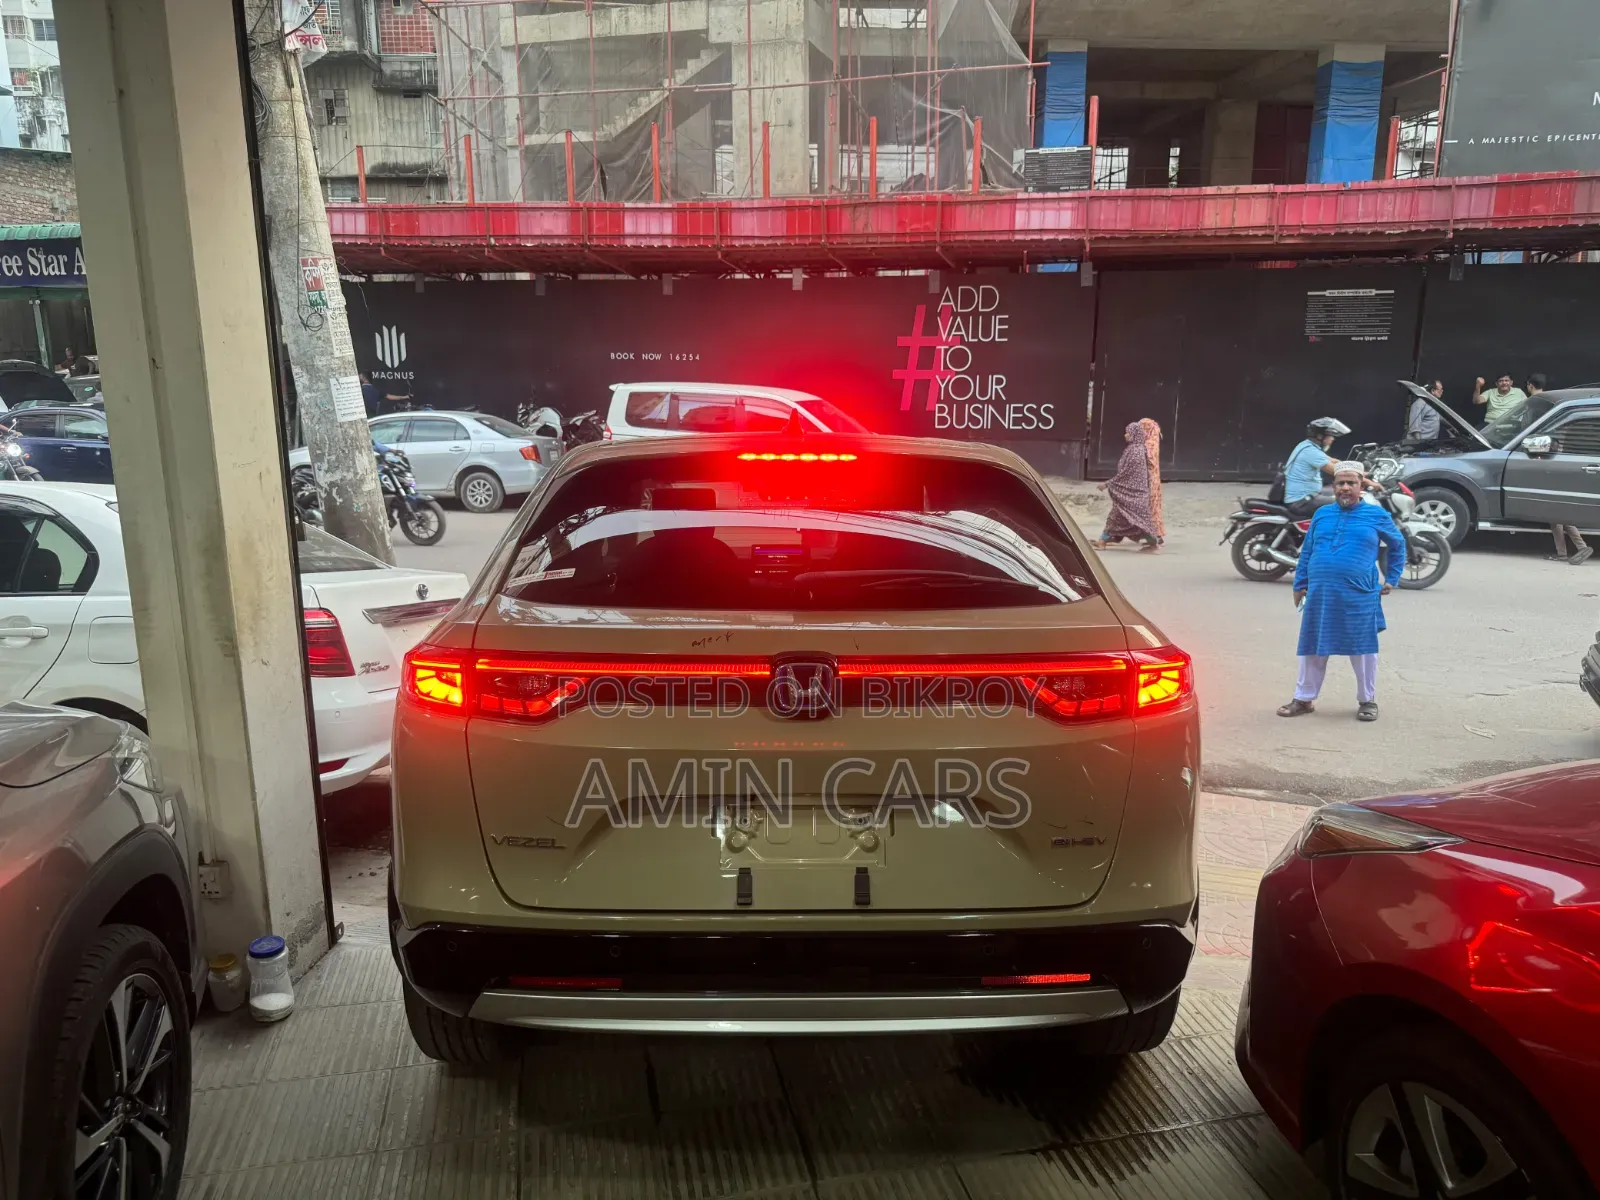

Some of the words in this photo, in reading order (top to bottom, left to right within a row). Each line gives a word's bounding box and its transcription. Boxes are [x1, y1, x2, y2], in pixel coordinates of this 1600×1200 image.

[1481, 135, 1539, 144] MAJESTIC
[0, 255, 24, 276] ee
[26, 246, 68, 276] Star
[937, 285, 1000, 312] ADD
[937, 315, 1009, 342] VALUE
[610, 352, 635, 360] BOOK
[642, 353, 662, 361] NOW
[669, 353, 700, 361] 16254
[936, 345, 972, 372] TO
[372, 371, 415, 380] MAGNUS
[935, 374, 1007, 401] YOUR
[934, 403, 1055, 430] BUSINESS
[490, 833, 567, 849] VEZEL
